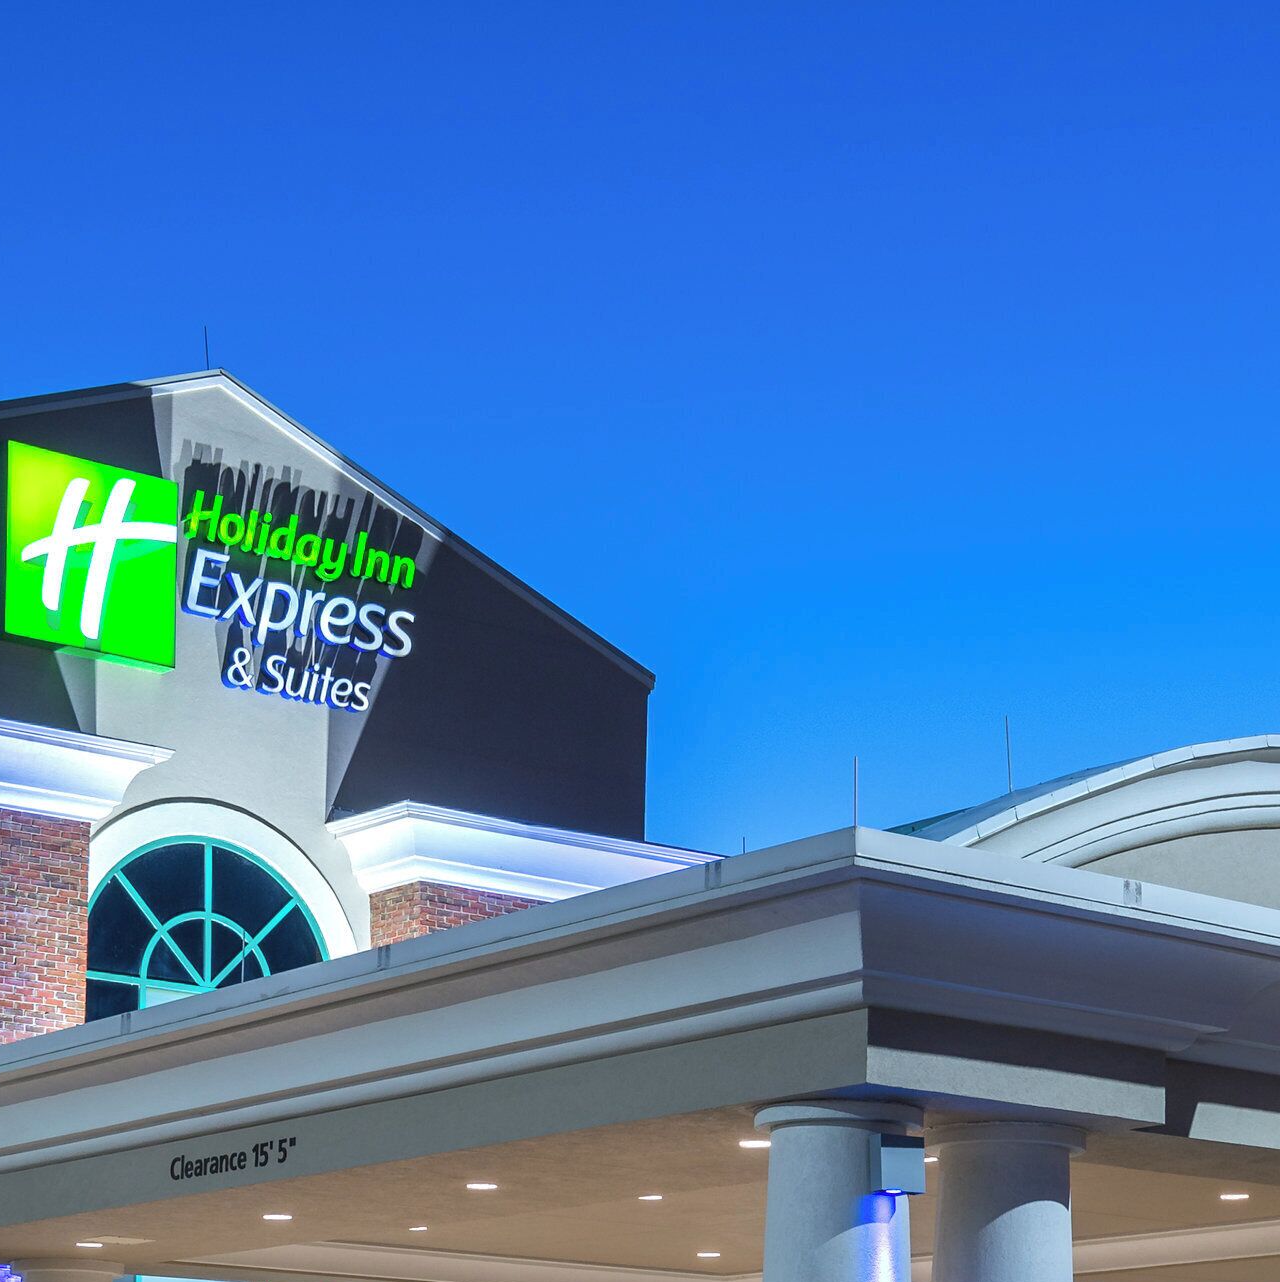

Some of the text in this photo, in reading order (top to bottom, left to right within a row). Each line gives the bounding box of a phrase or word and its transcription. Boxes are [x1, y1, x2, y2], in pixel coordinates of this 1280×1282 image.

[182, 490, 415, 588] Holiday Inn
[182, 549, 415, 659] Express
[222, 648, 371, 712] & Suites
[170, 1137, 296, 1180] Clearance 15' 5"
